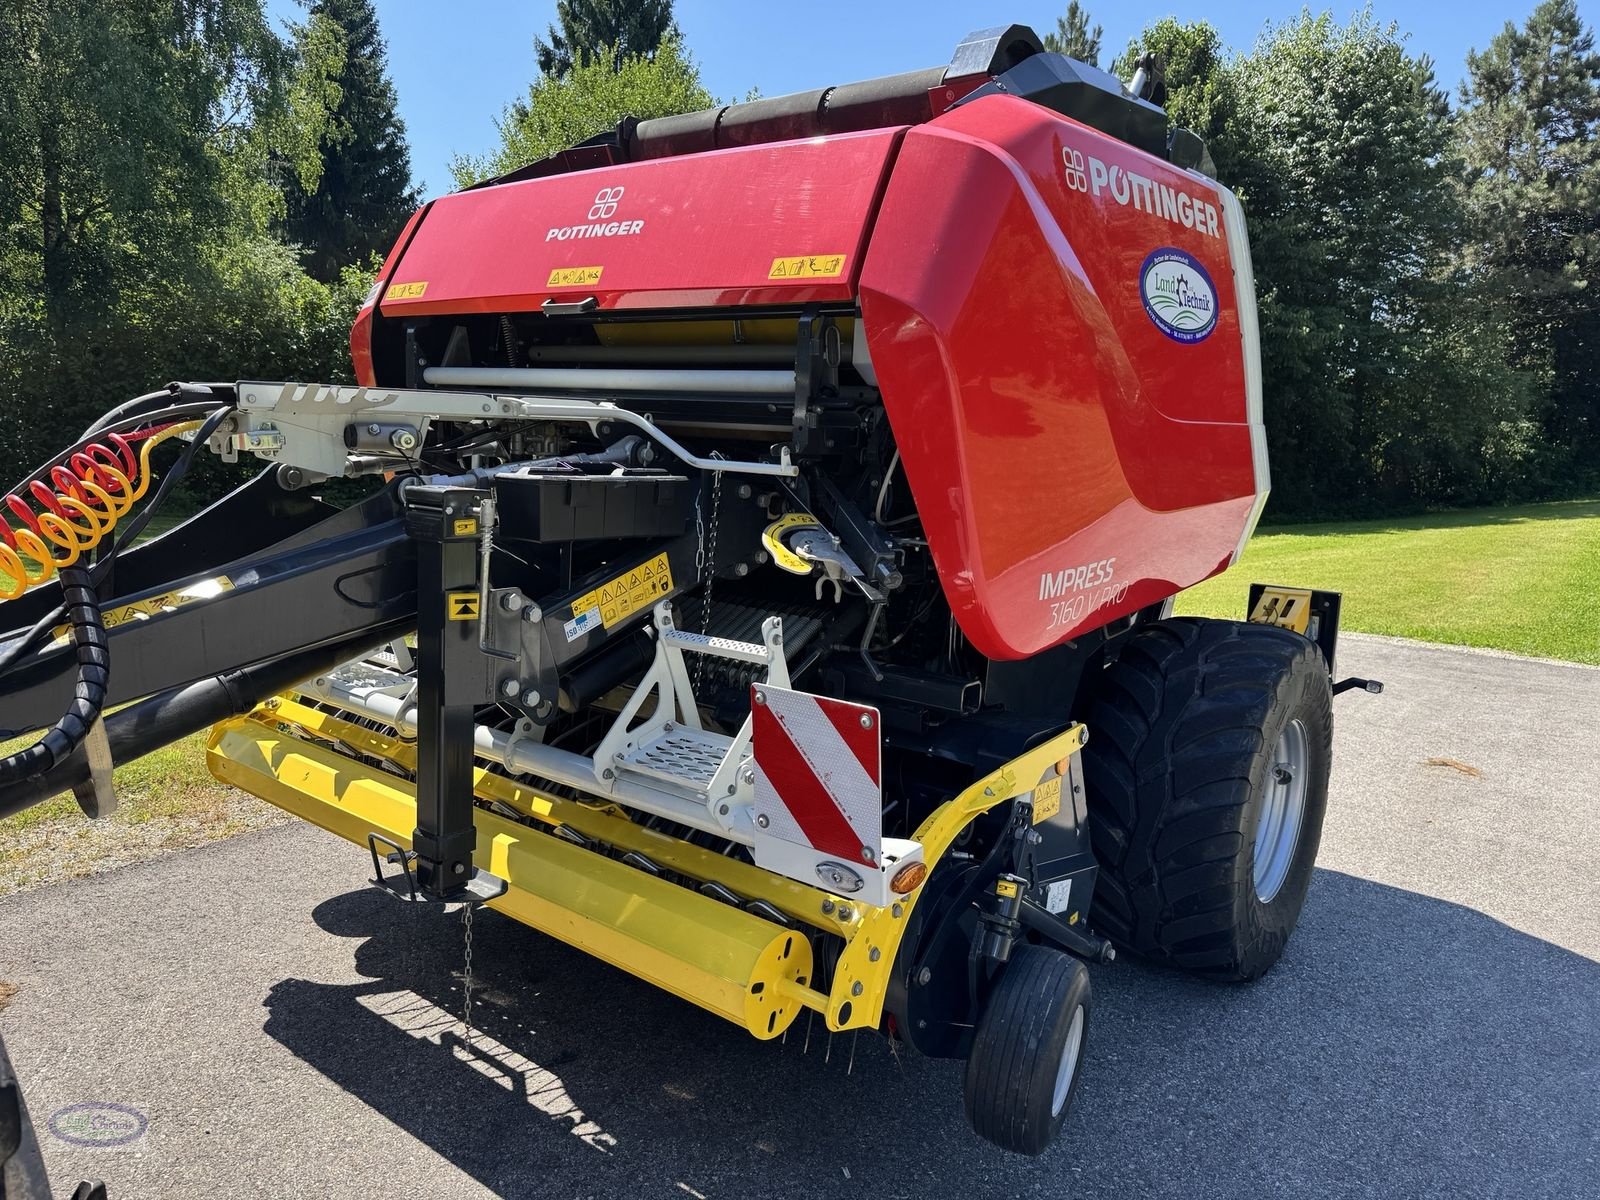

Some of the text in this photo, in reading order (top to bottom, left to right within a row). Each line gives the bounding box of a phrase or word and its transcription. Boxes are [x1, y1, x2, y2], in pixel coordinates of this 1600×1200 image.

[1155, 272, 1176, 294] Land
[1182, 290, 1210, 312] Technik
[1039, 558, 1116, 601] IMPRESS
[1046, 580, 1129, 630] 3160 V PRO
